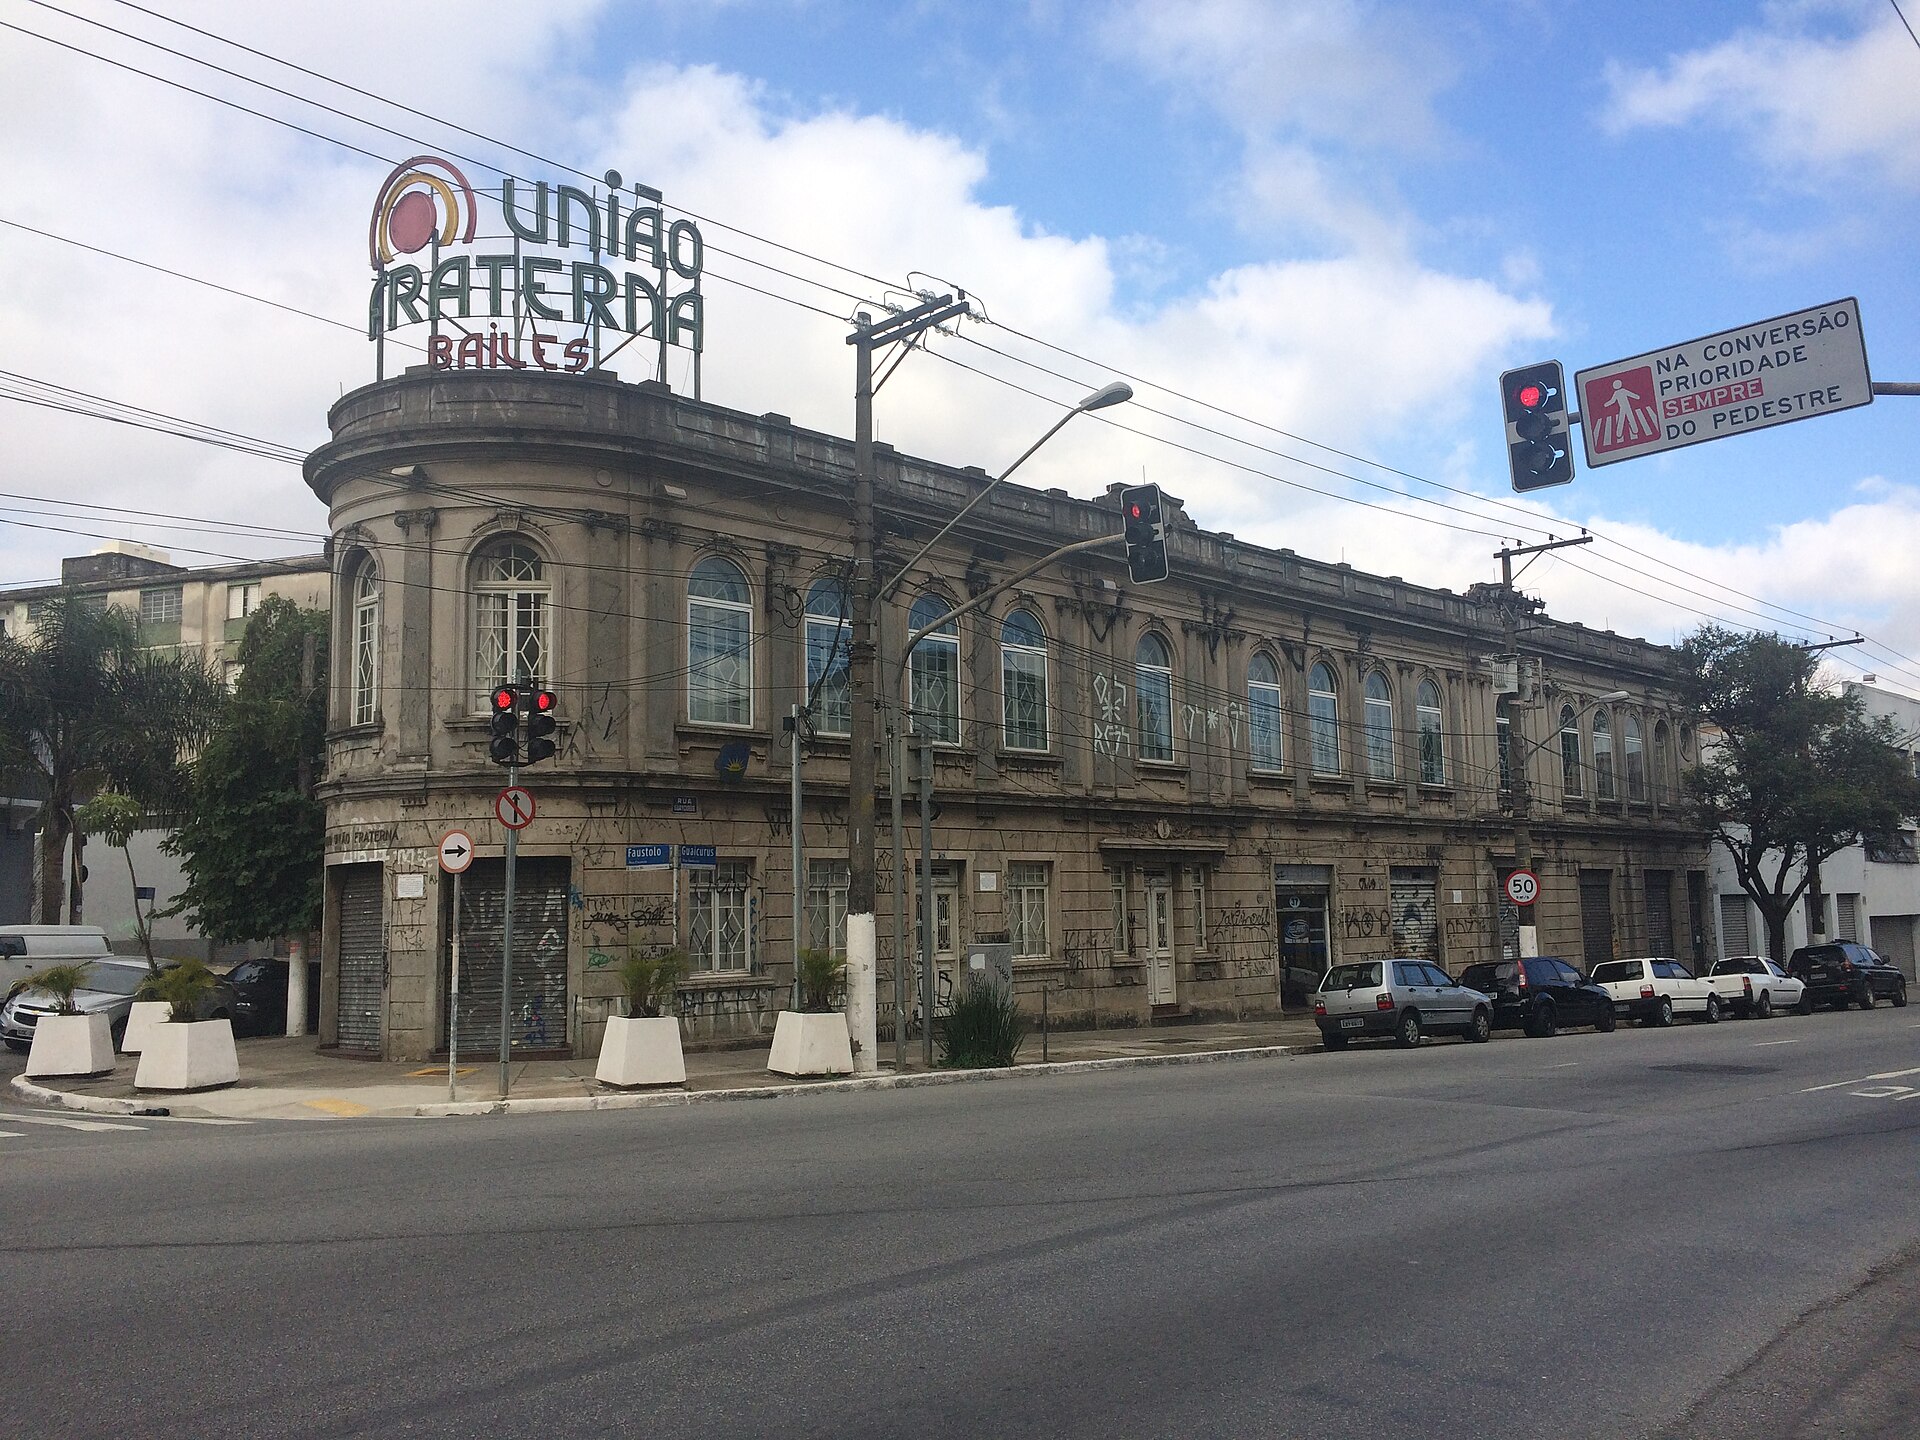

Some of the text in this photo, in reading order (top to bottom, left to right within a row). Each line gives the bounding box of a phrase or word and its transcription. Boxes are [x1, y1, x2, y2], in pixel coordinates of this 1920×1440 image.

[503, 169, 703, 279] UNIÃO
[369, 255, 703, 353] FRATERNA
[429, 322, 589, 372] BAILES
[1656, 310, 1850, 375] NA CONVERSÃO
[1659, 345, 1807, 396] PRIORIDADE
[1665, 380, 1762, 417] SEMPRE
[1665, 386, 1842, 441] DO PEDESTRE
[354, 828, 399, 844] FRATERNA
[627, 846, 662, 858] Faustolo
[681, 846, 715, 857] Guaicurus
[1513, 879, 1533, 893] 50
